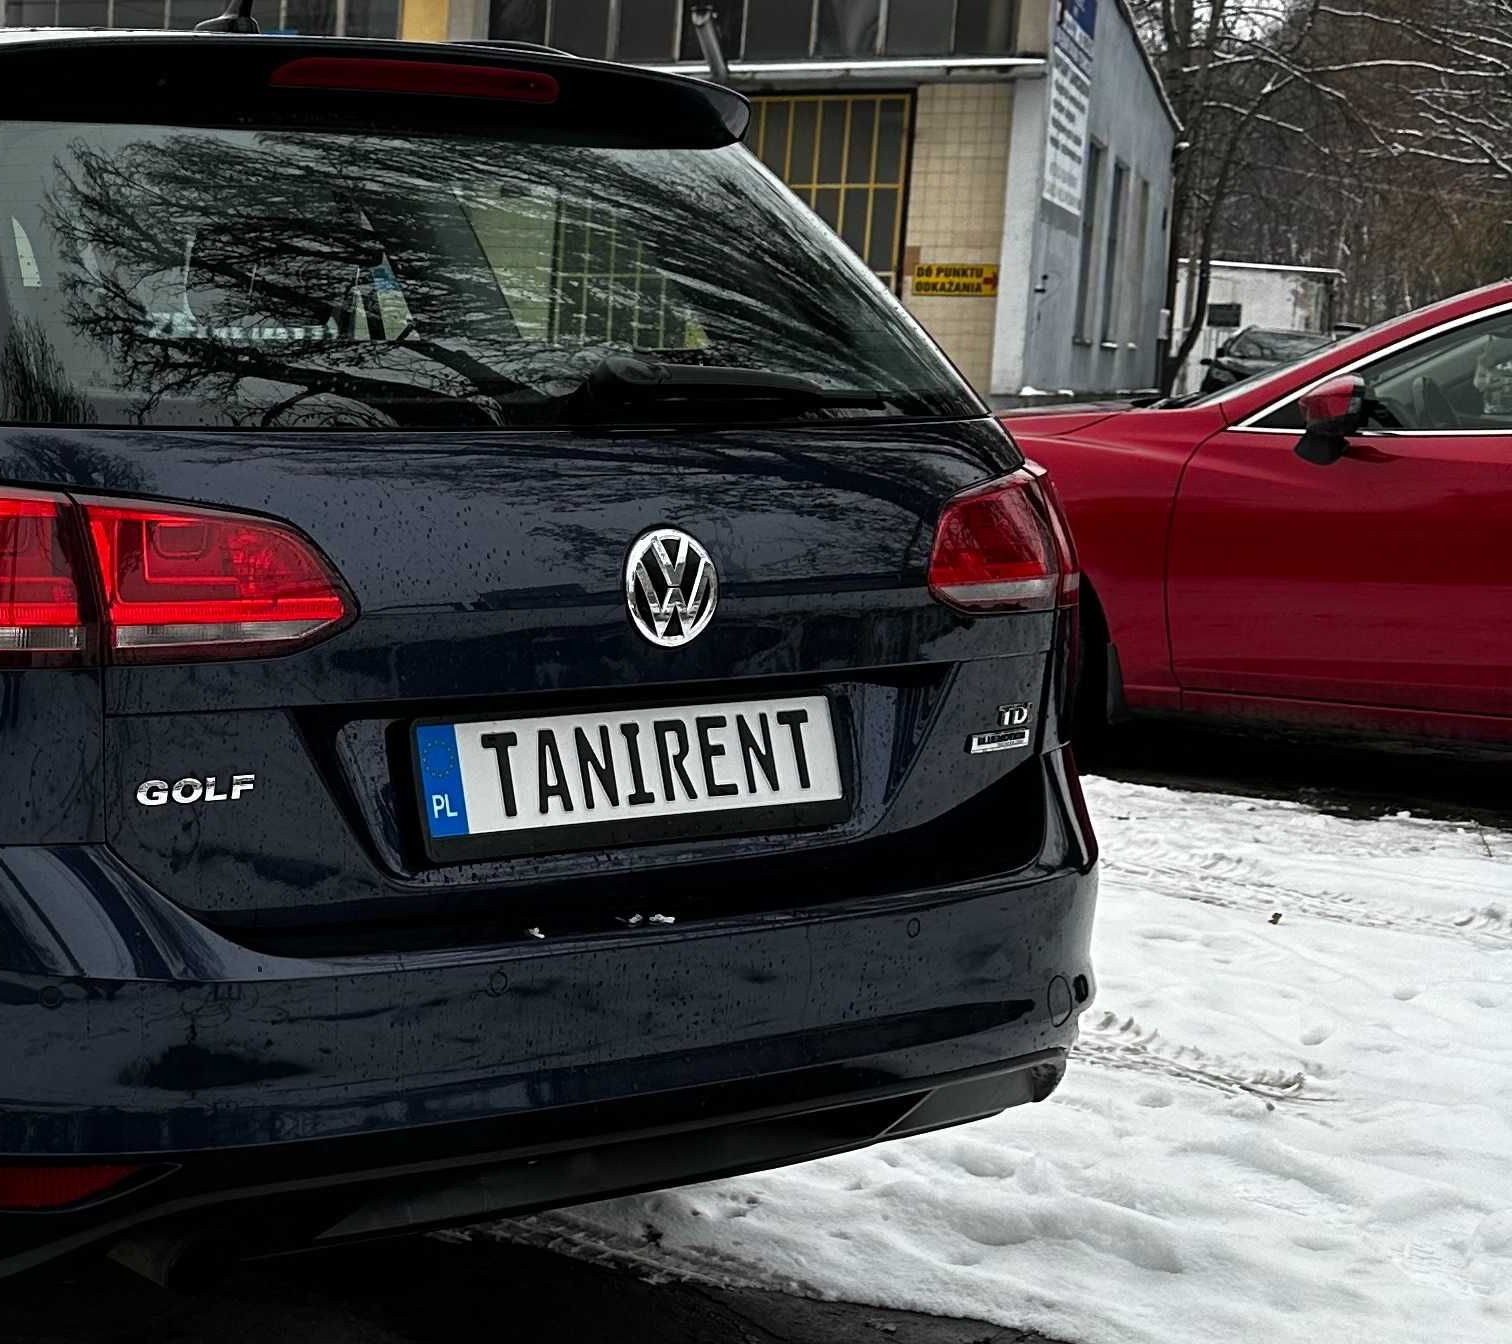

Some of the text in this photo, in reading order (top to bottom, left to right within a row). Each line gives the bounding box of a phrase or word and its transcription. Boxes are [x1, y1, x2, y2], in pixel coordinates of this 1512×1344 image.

[916, 265, 984, 278] DO PUNKTU
[431, 709, 811, 819] PL TANIRENT
[136, 774, 255, 806] GOLF
